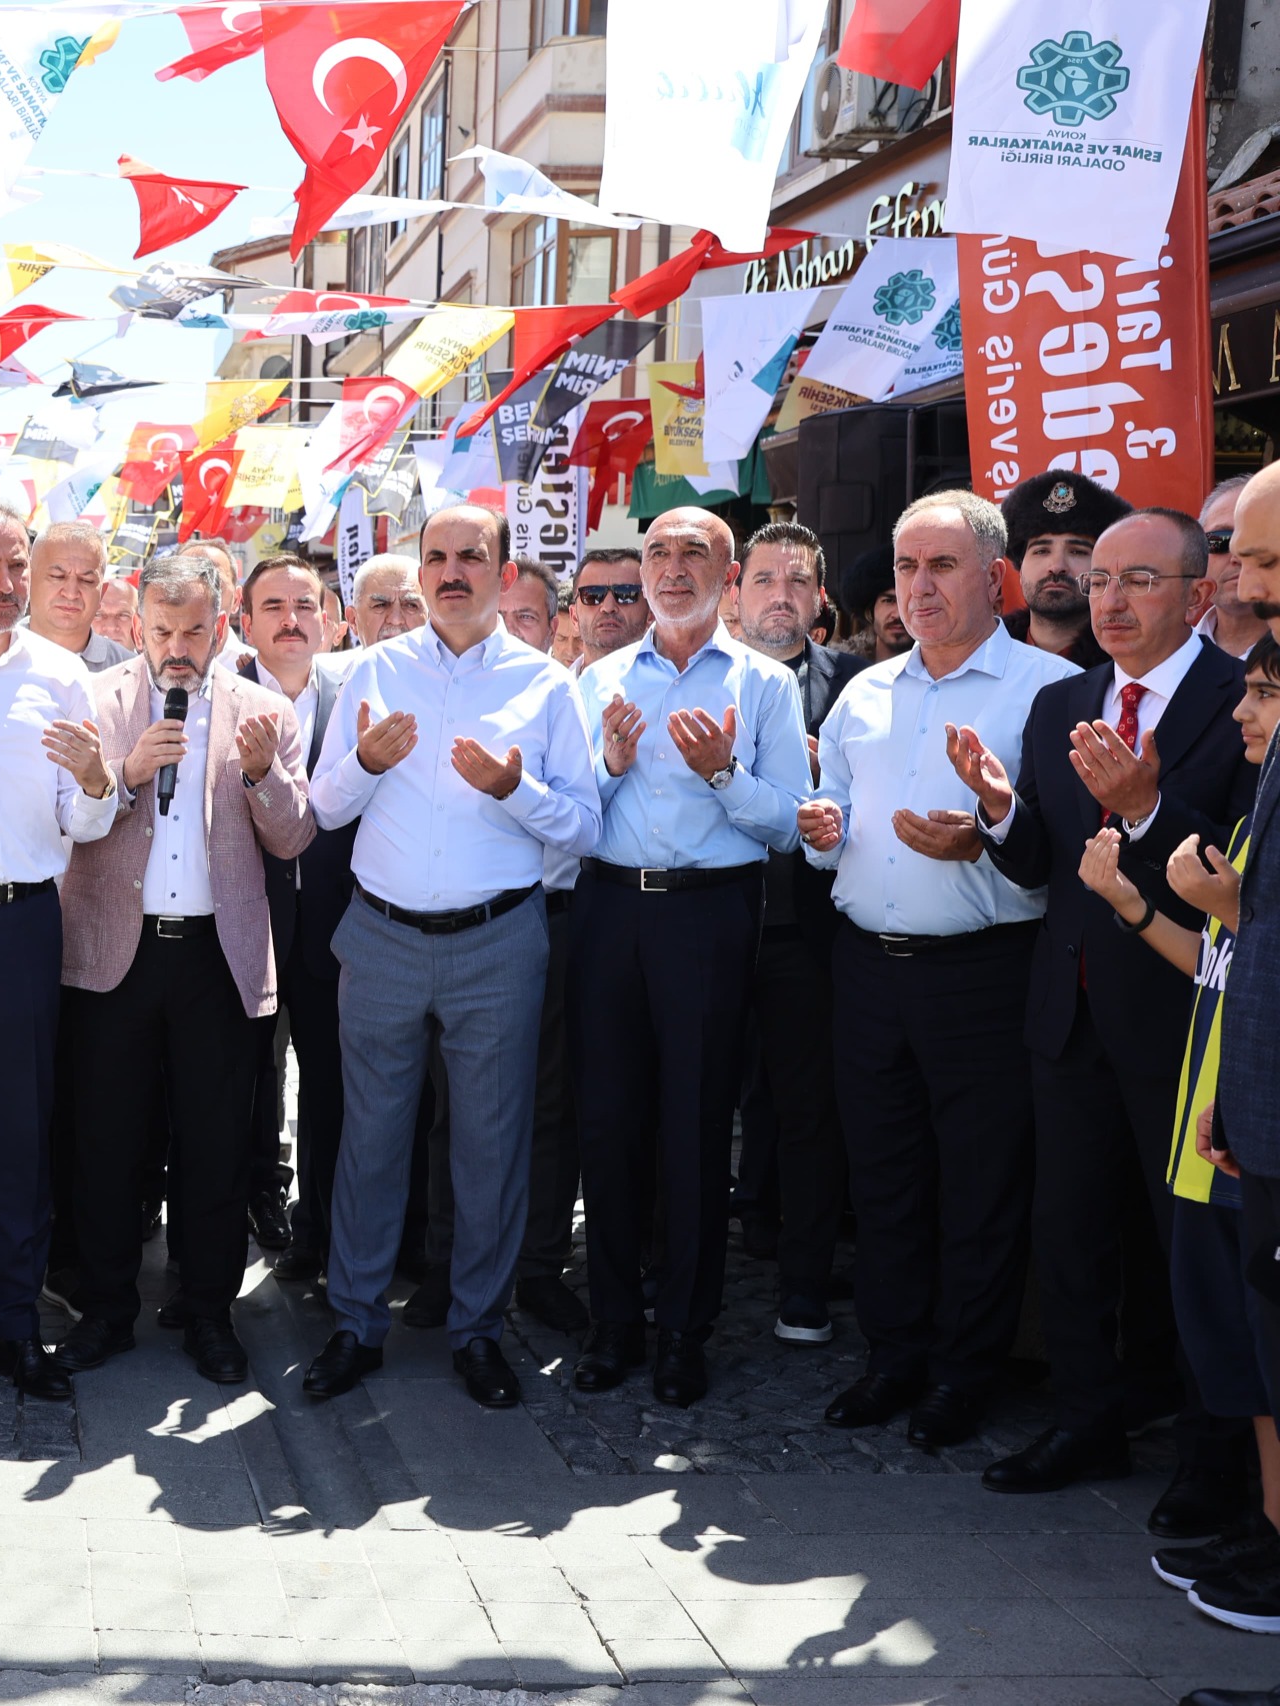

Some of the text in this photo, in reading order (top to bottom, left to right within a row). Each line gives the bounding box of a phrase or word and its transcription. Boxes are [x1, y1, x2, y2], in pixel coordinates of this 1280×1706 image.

[7, 63, 22, 83] VE
[26, 76, 48, 104] KONYA
[775, 239, 854, 294] Adnan
[832, 324, 862, 333] ESNAF
[862, 328, 875, 337] VE
[877, 324, 901, 336] KONYA
[847, 334, 887, 350] ODALARI
